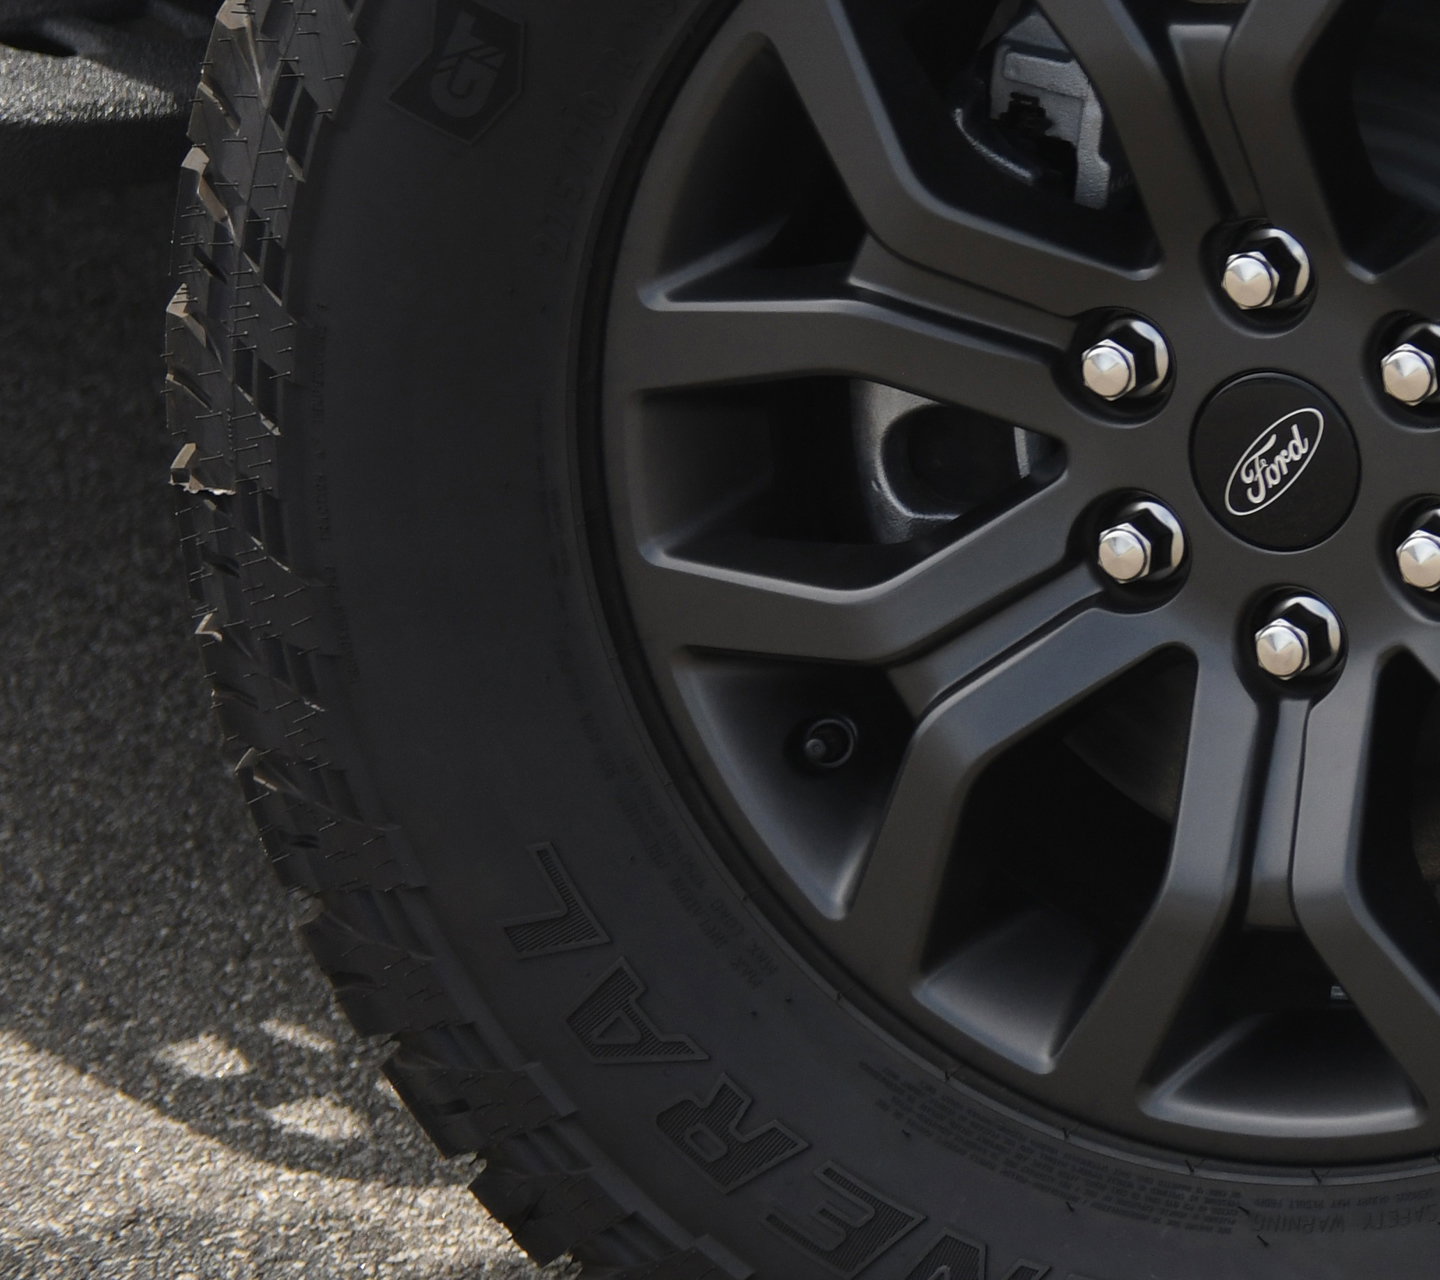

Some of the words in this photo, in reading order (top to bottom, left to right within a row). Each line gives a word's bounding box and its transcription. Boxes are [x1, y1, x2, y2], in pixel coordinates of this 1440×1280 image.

[1240, 423, 1309, 504] Ford
[1249, 1213, 1346, 1232] WARNING
[1360, 1201, 1440, 1232] SAFETY
